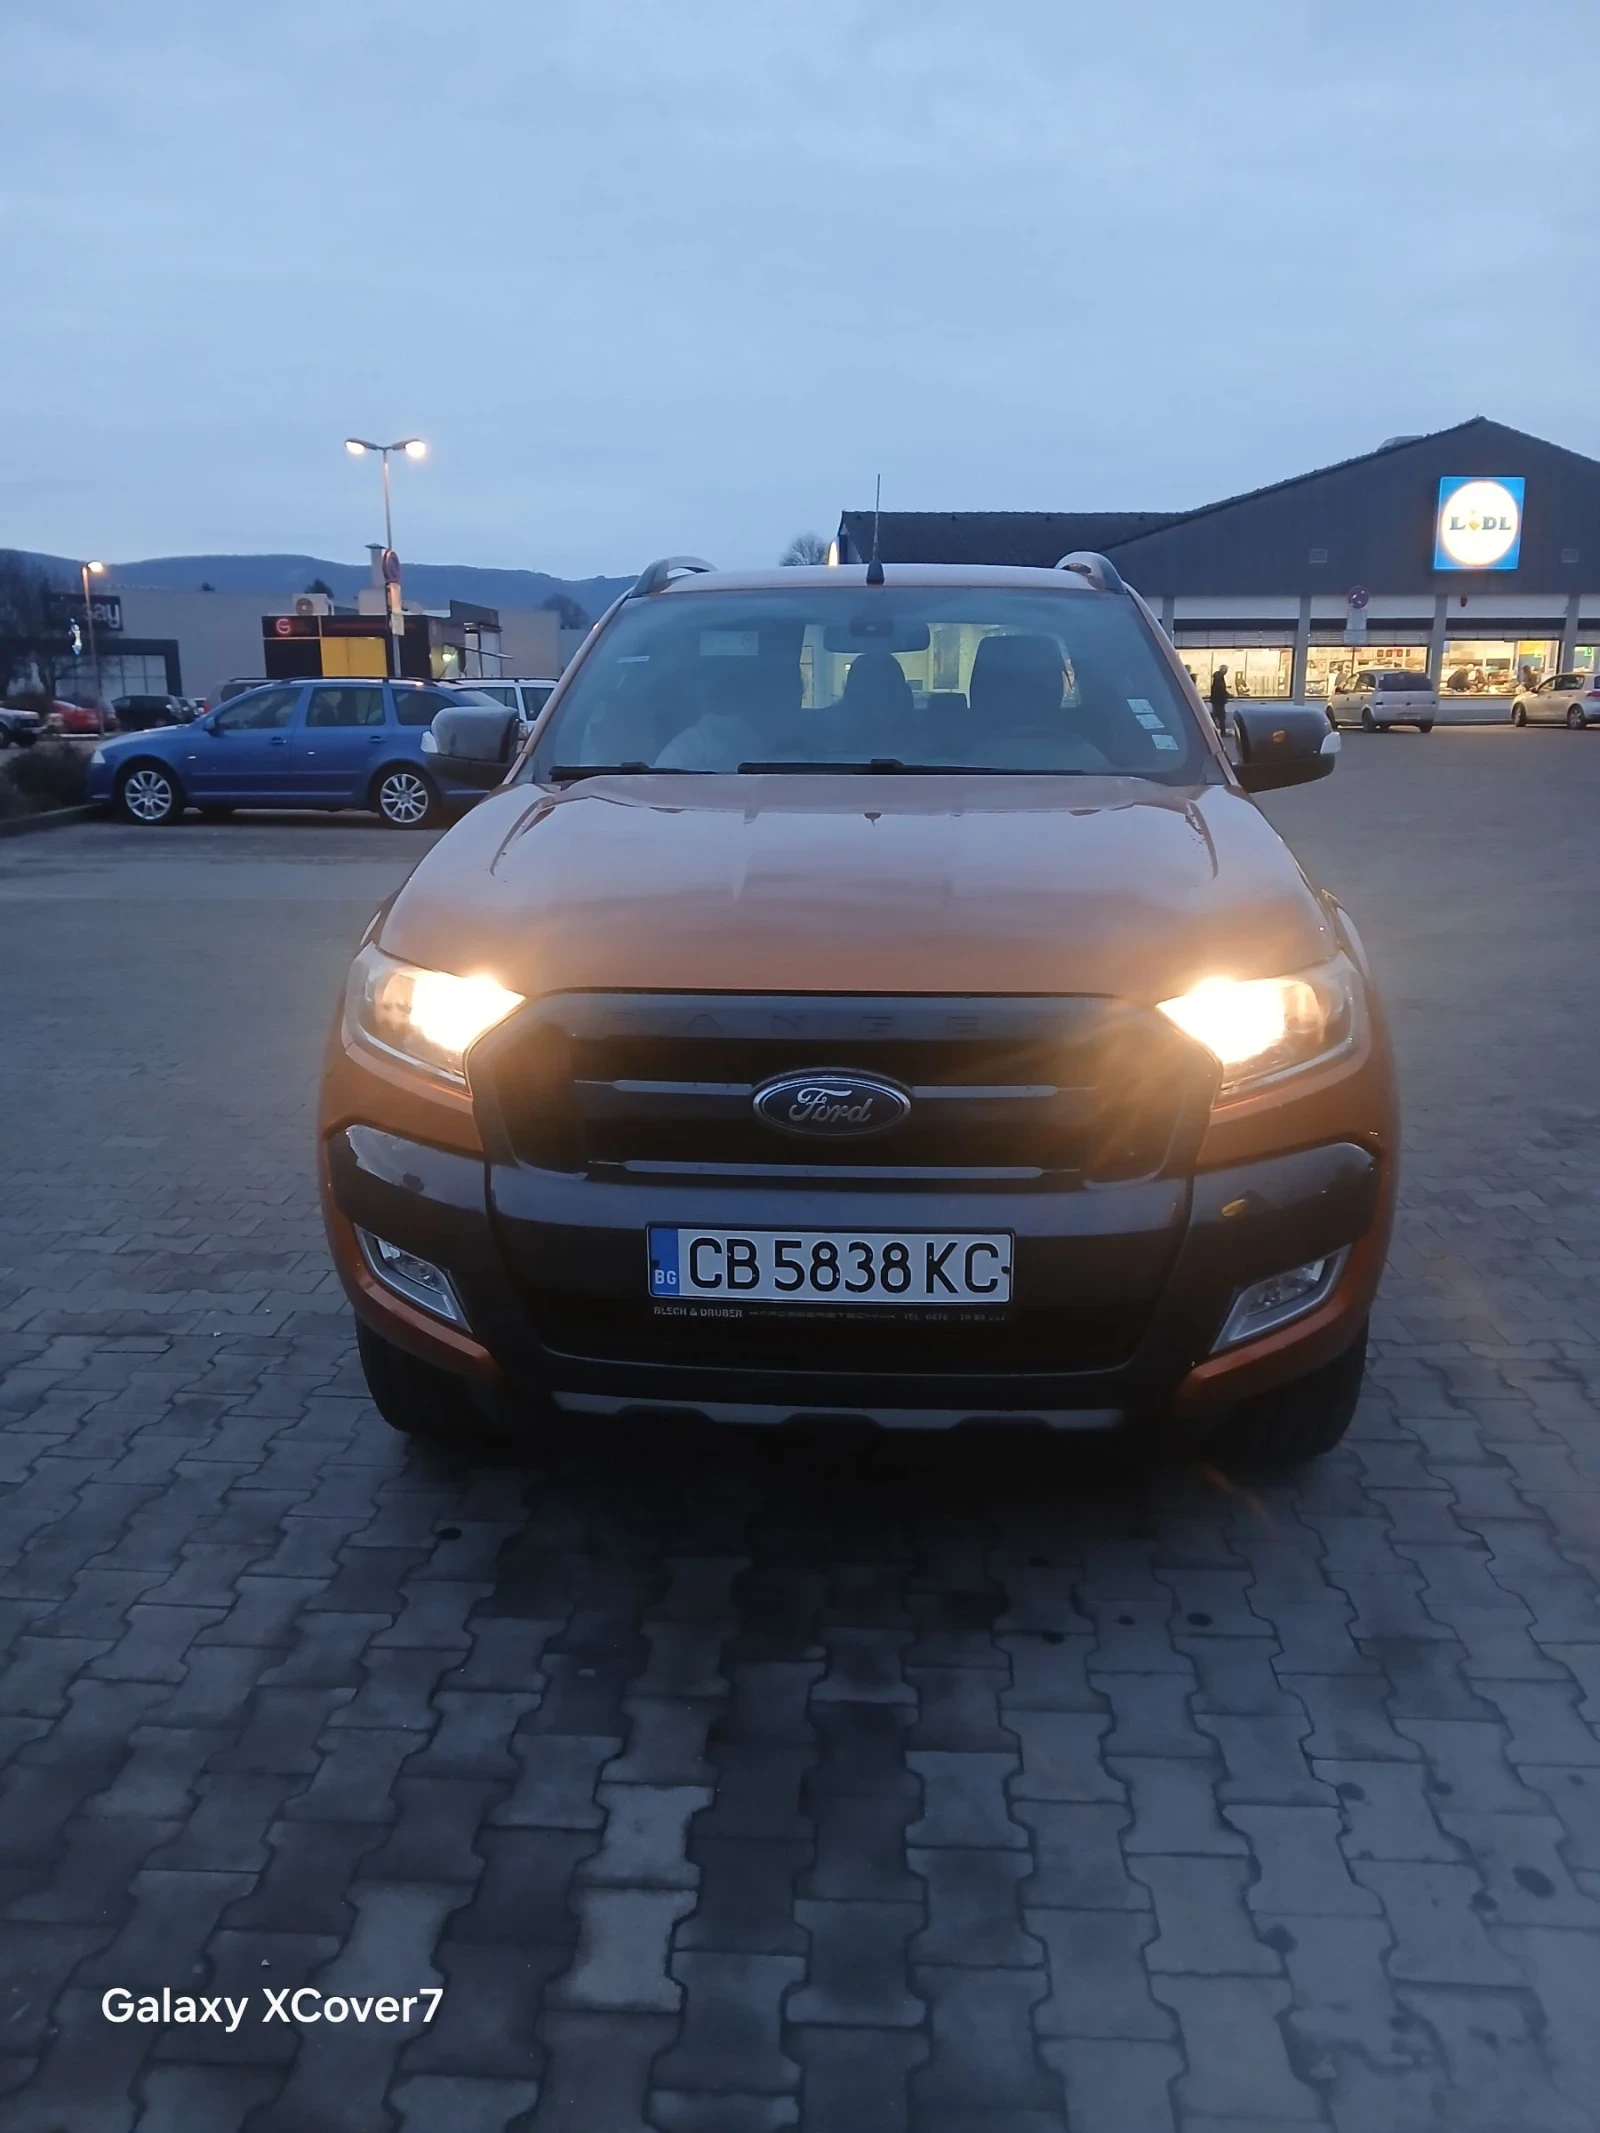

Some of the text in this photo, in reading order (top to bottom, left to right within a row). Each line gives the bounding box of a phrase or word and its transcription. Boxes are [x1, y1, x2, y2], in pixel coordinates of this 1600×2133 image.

[1449, 509, 1511, 531] LIDL
[788, 1087, 873, 1122] Ford
[654, 1269, 677, 1285] BG
[689, 1237, 999, 1294] CB 5838 KC
